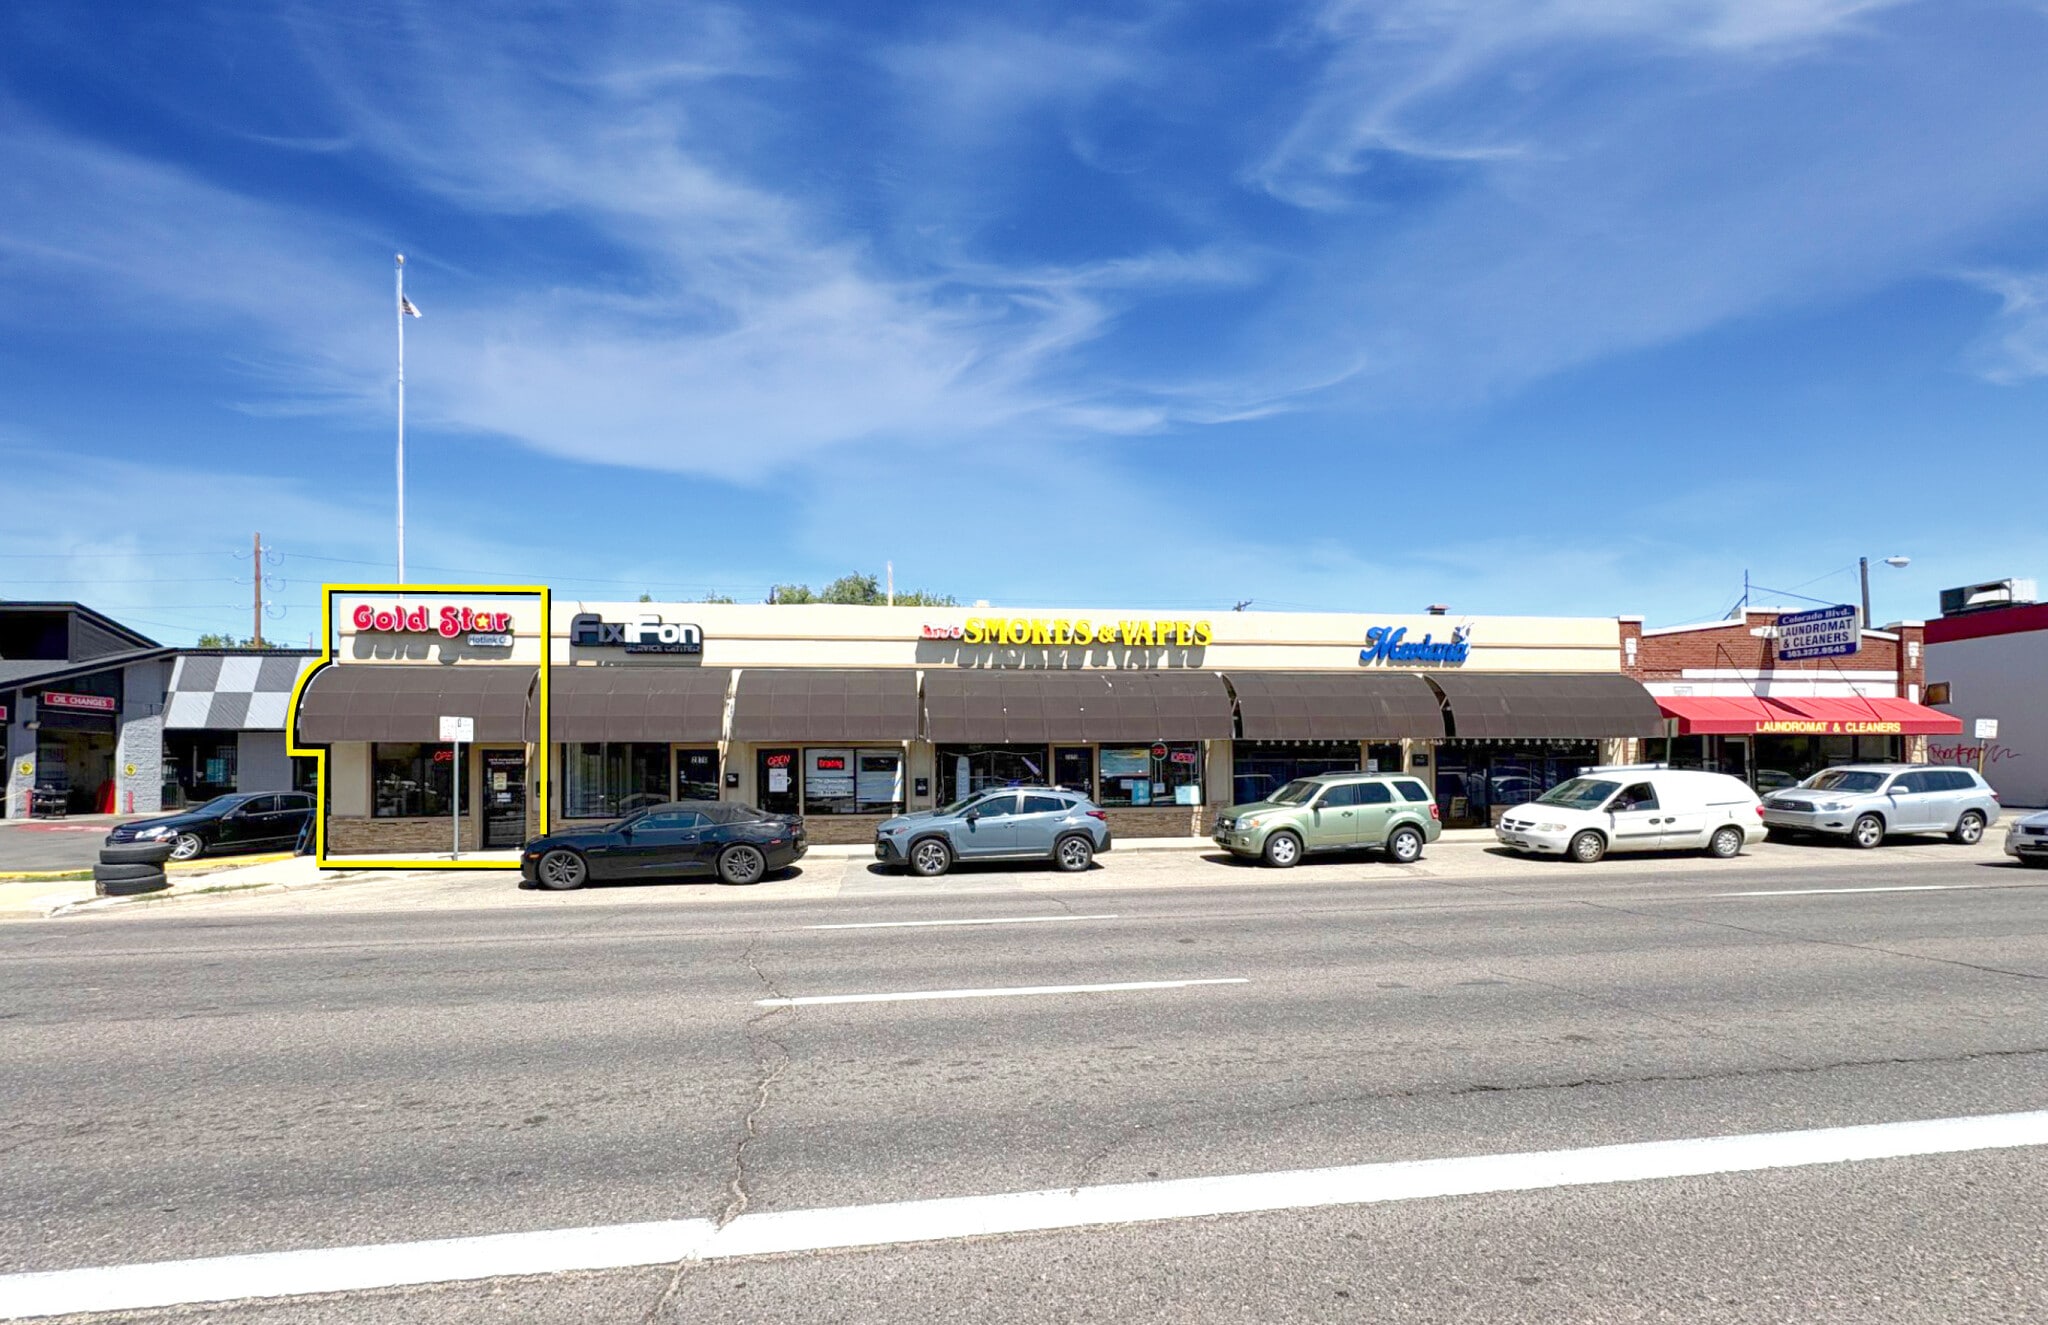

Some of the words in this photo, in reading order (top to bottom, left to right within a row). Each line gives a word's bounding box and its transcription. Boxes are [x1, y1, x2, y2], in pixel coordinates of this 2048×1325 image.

[353, 604, 429, 632] Gold
[438, 606, 512, 638] Star
[1782, 612, 1823, 624] Colorado
[1825, 608, 1850, 618] Blvd.
[963, 617, 1093, 645] SMOKES
[1098, 624, 1116, 643] &
[1119, 620, 1213, 646] VAPES
[1780, 619, 1852, 638] LAUNDROMAT
[1783, 638, 1790, 648] &
[1793, 631, 1849, 647] CLEANERS
[69, 697, 107, 707] CHANGES
[1756, 721, 1828, 732] LAUNDROMAT
[1832, 722, 1841, 733] &
[1845, 722, 1901, 733] CLEANERS
[767, 755, 791, 766] OPEN
